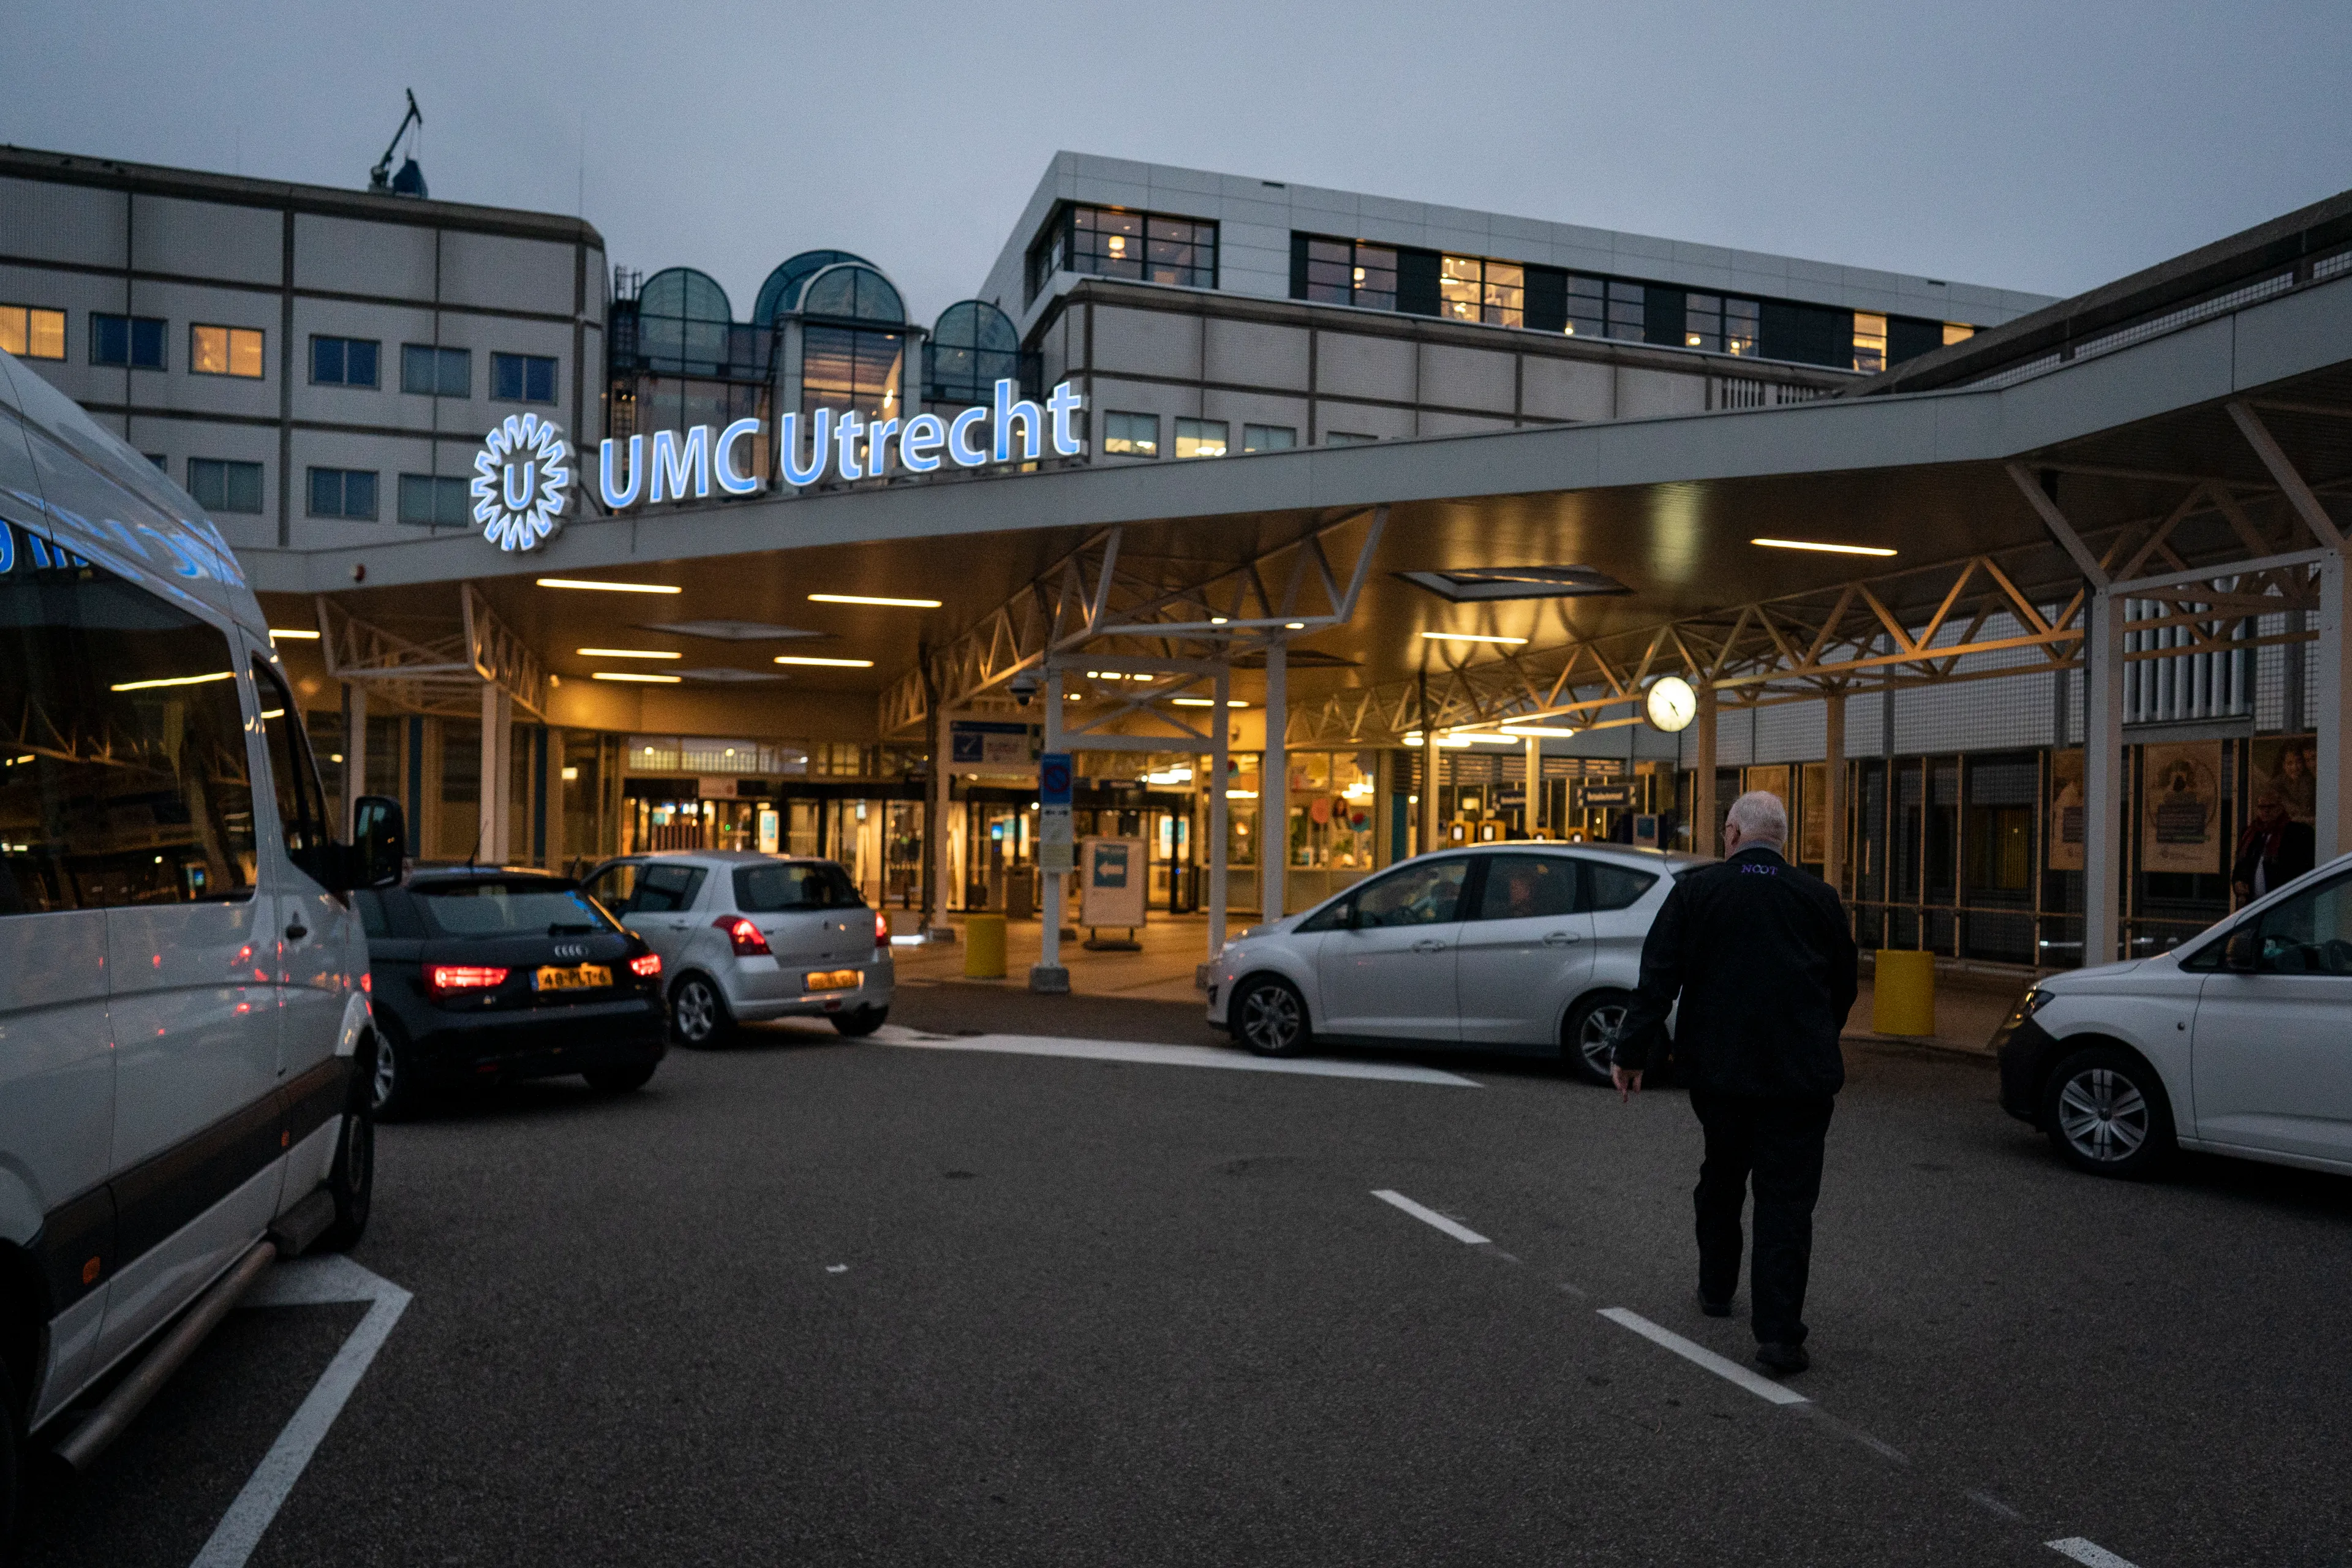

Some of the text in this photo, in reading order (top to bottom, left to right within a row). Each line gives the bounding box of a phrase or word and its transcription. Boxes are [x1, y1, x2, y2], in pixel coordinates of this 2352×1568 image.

[600, 378, 1082, 509] UMC Utrecht
[503, 462, 534, 511] U
[1741, 864, 1778, 875] NOOT
